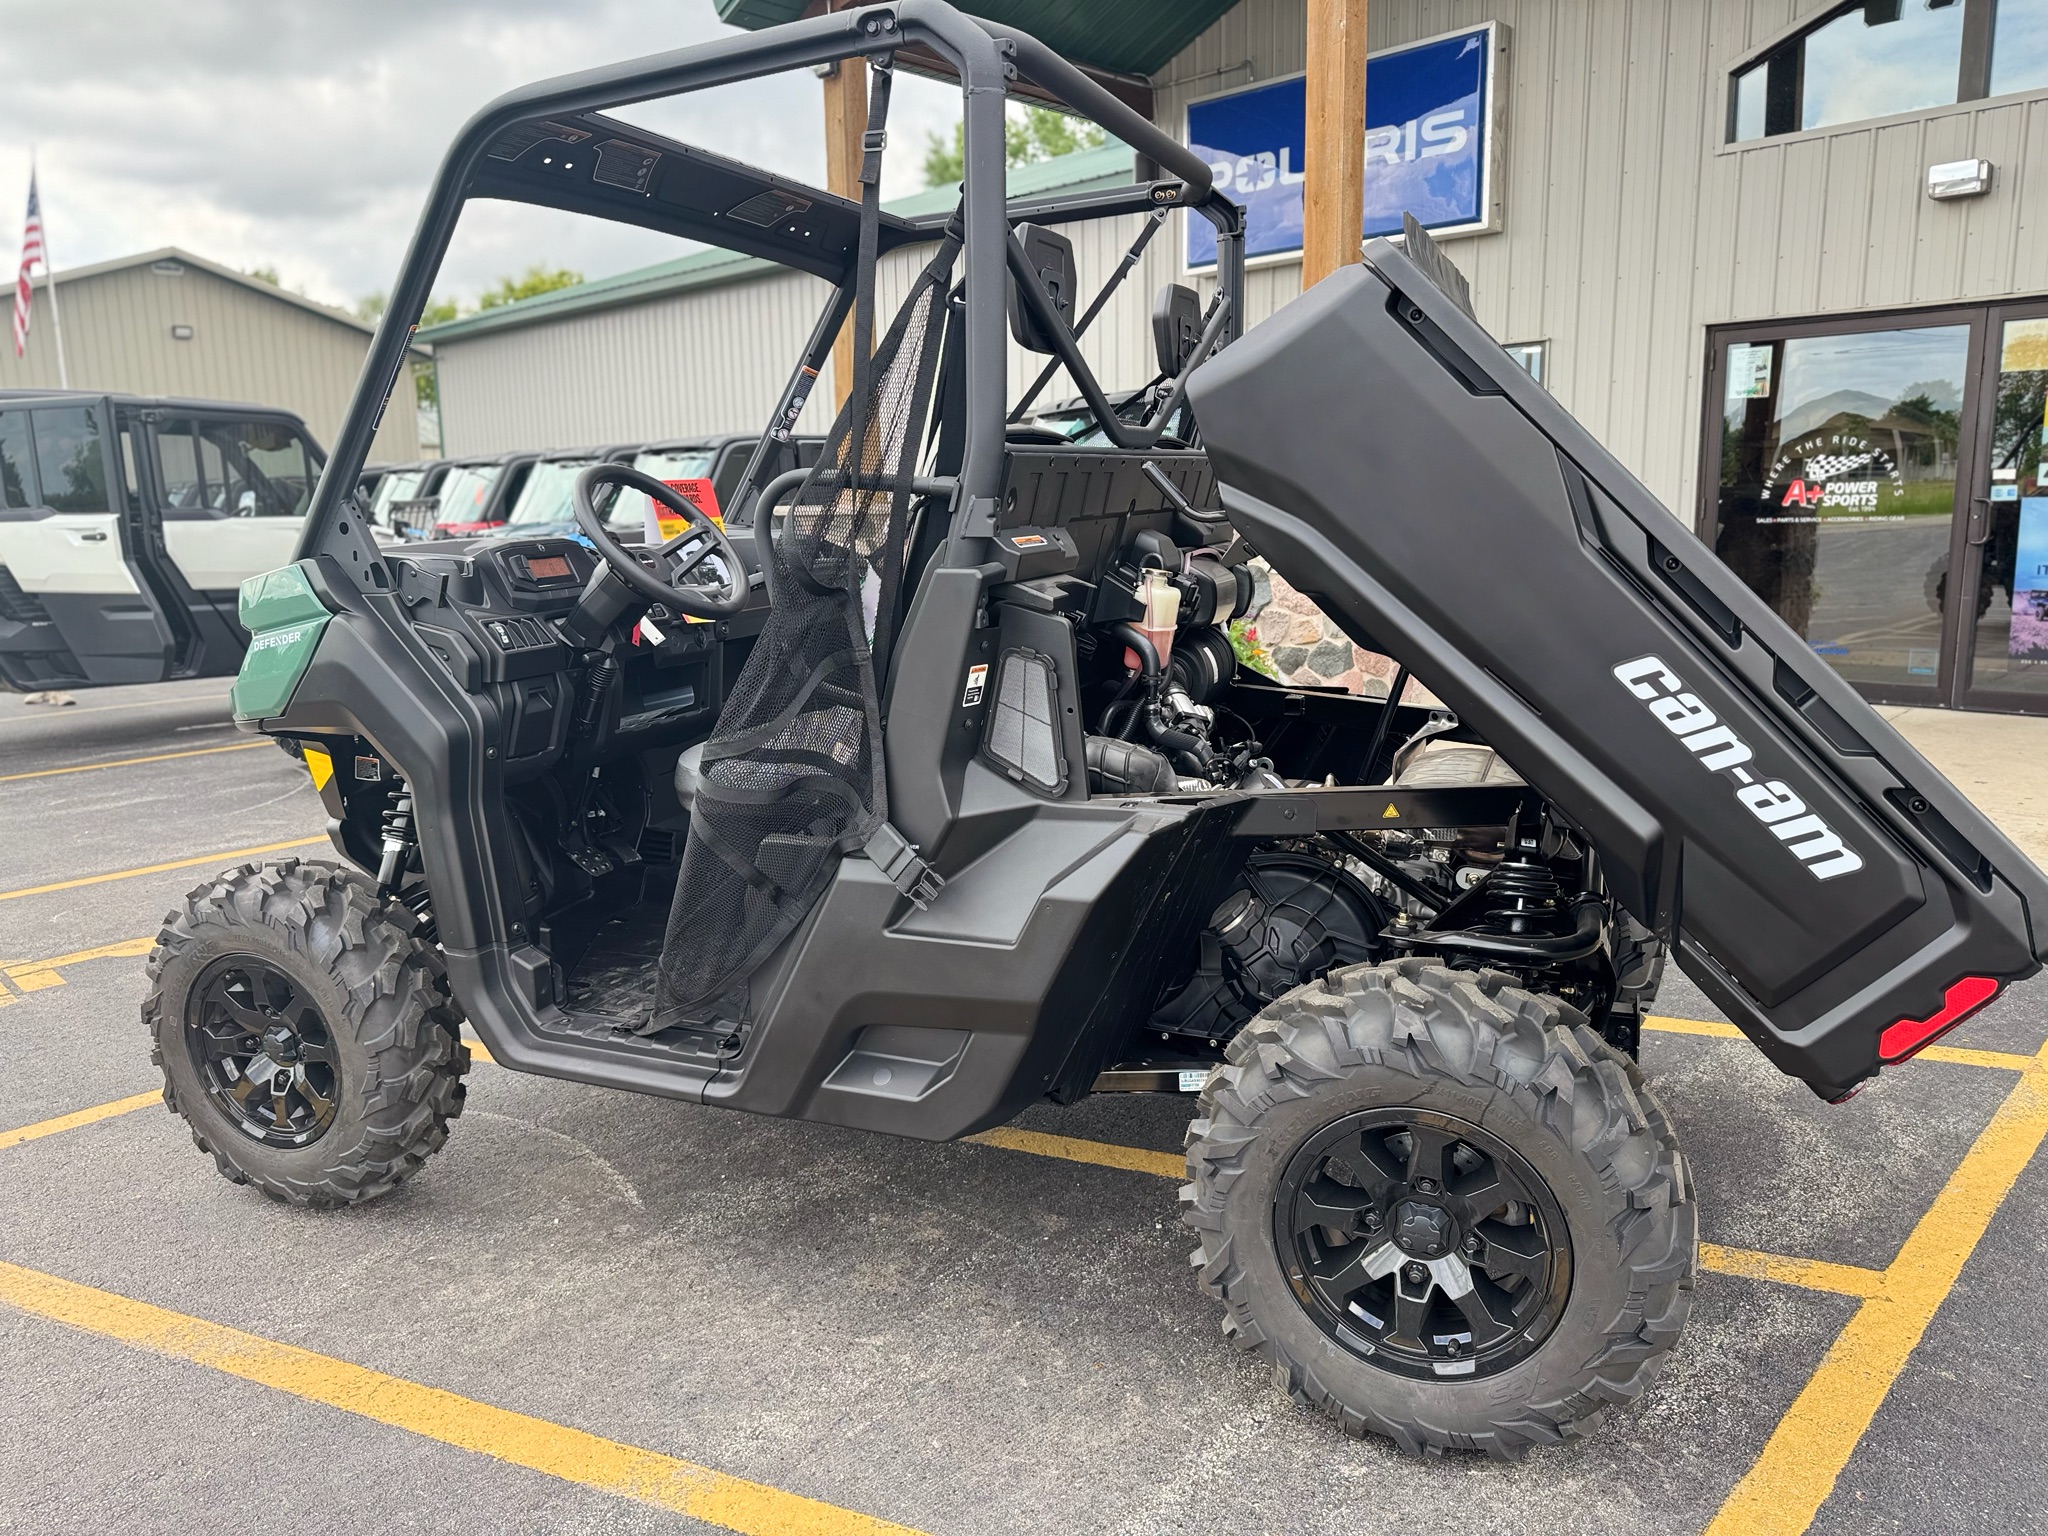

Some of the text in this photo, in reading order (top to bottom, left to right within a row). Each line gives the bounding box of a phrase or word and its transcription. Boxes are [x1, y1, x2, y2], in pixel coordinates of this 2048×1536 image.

[1206, 109, 1467, 193] POLRIS
[1761, 435, 1904, 499] WHERE THE RIDE STARTS
[1781, 478, 1878, 508] A+ POWER
[1822, 494, 1878, 506] SPORTS
[253, 632, 301, 651] DEFENDER
[1614, 656, 1863, 879] can-am
